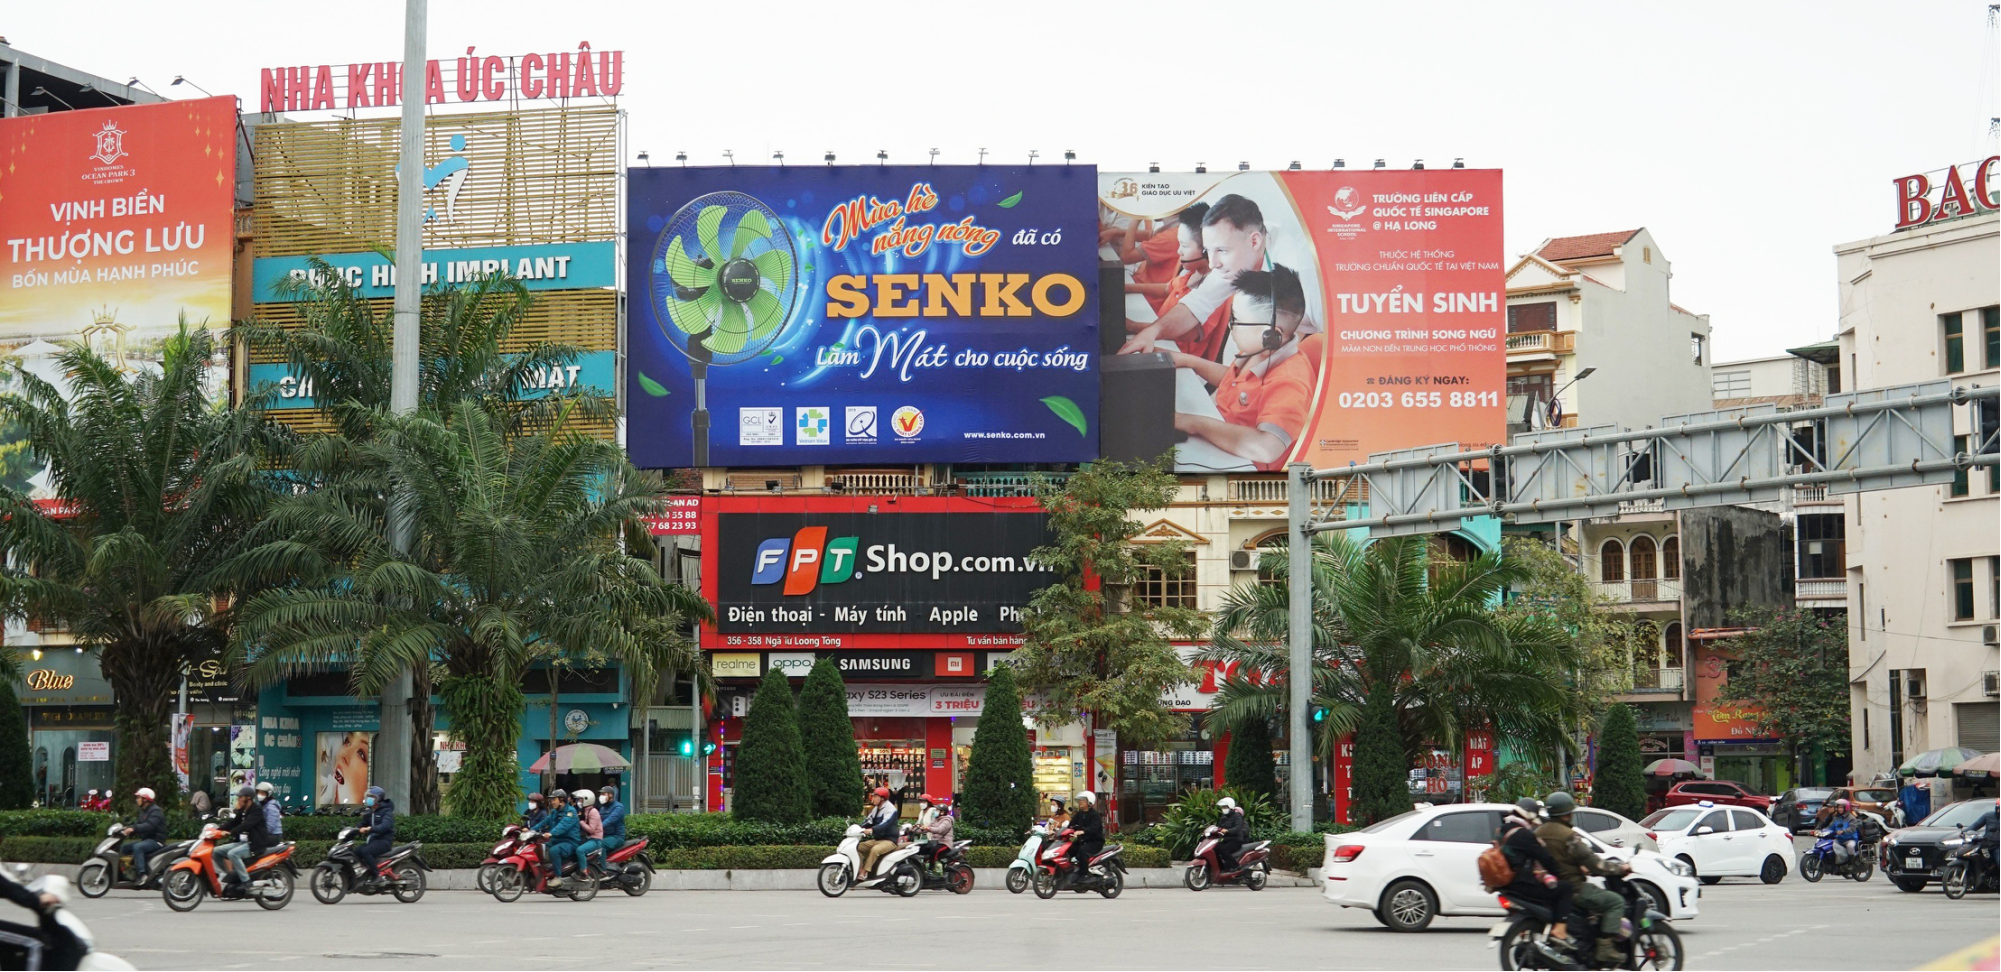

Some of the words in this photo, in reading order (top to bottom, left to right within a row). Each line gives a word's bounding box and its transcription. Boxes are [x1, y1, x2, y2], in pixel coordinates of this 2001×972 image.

[260, 64, 336, 113] NHA
[348, 60, 446, 107] KHA
[457, 46, 505, 102] ÚC
[520, 41, 623, 98] CHÂU
[82, 172, 107, 180] OCEAN
[1372, 192, 1420, 204] TRƯỜNG
[1424, 192, 1447, 203] LIÊN
[1450, 190, 1473, 203] CẤP
[50, 199, 105, 226] VỊNH
[112, 188, 164, 217] BIỂN
[1372, 205, 1406, 217] QUỐC
[1410, 205, 1422, 217] TẾ
[1425, 207, 1489, 216] SINGAPORE
[823, 195, 901, 250] Mùa
[905, 183, 938, 214] hè
[1372, 221, 1382, 230] @
[1384, 221, 1400, 232] HẠ
[1404, 220, 1437, 230] LONG
[7, 229, 134, 264] THƯỢNG
[145, 221, 204, 253] LƯU
[872, 216, 933, 256] nắng
[937, 216, 1001, 256] nóng
[1012, 229, 1037, 245] đã
[1041, 229, 1062, 245] có
[1379, 250, 1408, 260] THUỘC
[1410, 250, 1421, 260] HỆ
[1424, 249, 1454, 258] THỐNG
[12, 268, 48, 288] BỐN
[53, 267, 92, 286] MÙA
[97, 264, 146, 284] HẠNH
[151, 258, 199, 278] PHÚC
[1336, 262, 1370, 272] TRƯỜNG
[1406, 260, 1432, 271] QUỐC
[1434, 260, 1444, 270] TẾ
[1446, 262, 1458, 272] TẠI
[1460, 262, 1476, 272] VIỆT
[372, 262, 438, 287] HH
[826, 273, 1086, 318] SENKO
[1337, 285, 1423, 314] TUYỂN
[1433, 292, 1498, 313] SINH
[1340, 330, 1392, 340] CHƯƠNG
[1394, 328, 1428, 340] TRÌNH
[1432, 330, 1466, 340] SONG
[1470, 328, 1496, 339] NGỮ
[855, 326, 947, 381] Mát
[955, 350, 989, 366] cho
[994, 349, 1038, 370] cuộc
[1042, 346, 1088, 370] sống
[1384, 342, 1400, 352] ĐẾN
[1430, 344, 1448, 354] HỌC
[1468, 344, 1496, 352] THÔNG
[1379, 375, 1412, 385] ĐĂNG
[1416, 376, 1430, 385] KÝ
[1433, 376, 1470, 385] NGAY:
[1338, 392, 1393, 408] 0203
[1401, 392, 1442, 408] 655
[1450, 391, 1498, 408] 8811
[964, 430, 1045, 439] www.senko.com.vn
[728, 606, 765, 627] Điện
[772, 606, 812, 626] thoại
[834, 605, 868, 626] Máy
[876, 605, 907, 622] tính
[929, 606, 978, 627] Apple
[727, 636, 742, 645] 356
[748, 636, 762, 645] 358
[766, 636, 782, 647] Ngã
[794, 637, 820, 647] Loong
[966, 636, 976, 645] Tư
[978, 634, 992, 644] vấn
[993, 636, 1008, 644] bán
[716, 659, 756, 669] realme
[773, 660, 812, 668] oppo
[840, 658, 911, 670] SAMSUNG
[27, 669, 74, 691] Blue
[868, 690, 887, 700] S23
[890, 690, 926, 700] Series
[935, 700, 942, 710] 3
[945, 699, 980, 710] TRIỆU
[262, 716, 278, 728] NHA
[280, 717, 300, 730] KHOA
[264, 732, 275, 747] ÚC
[278, 734, 297, 748] CHÂU
